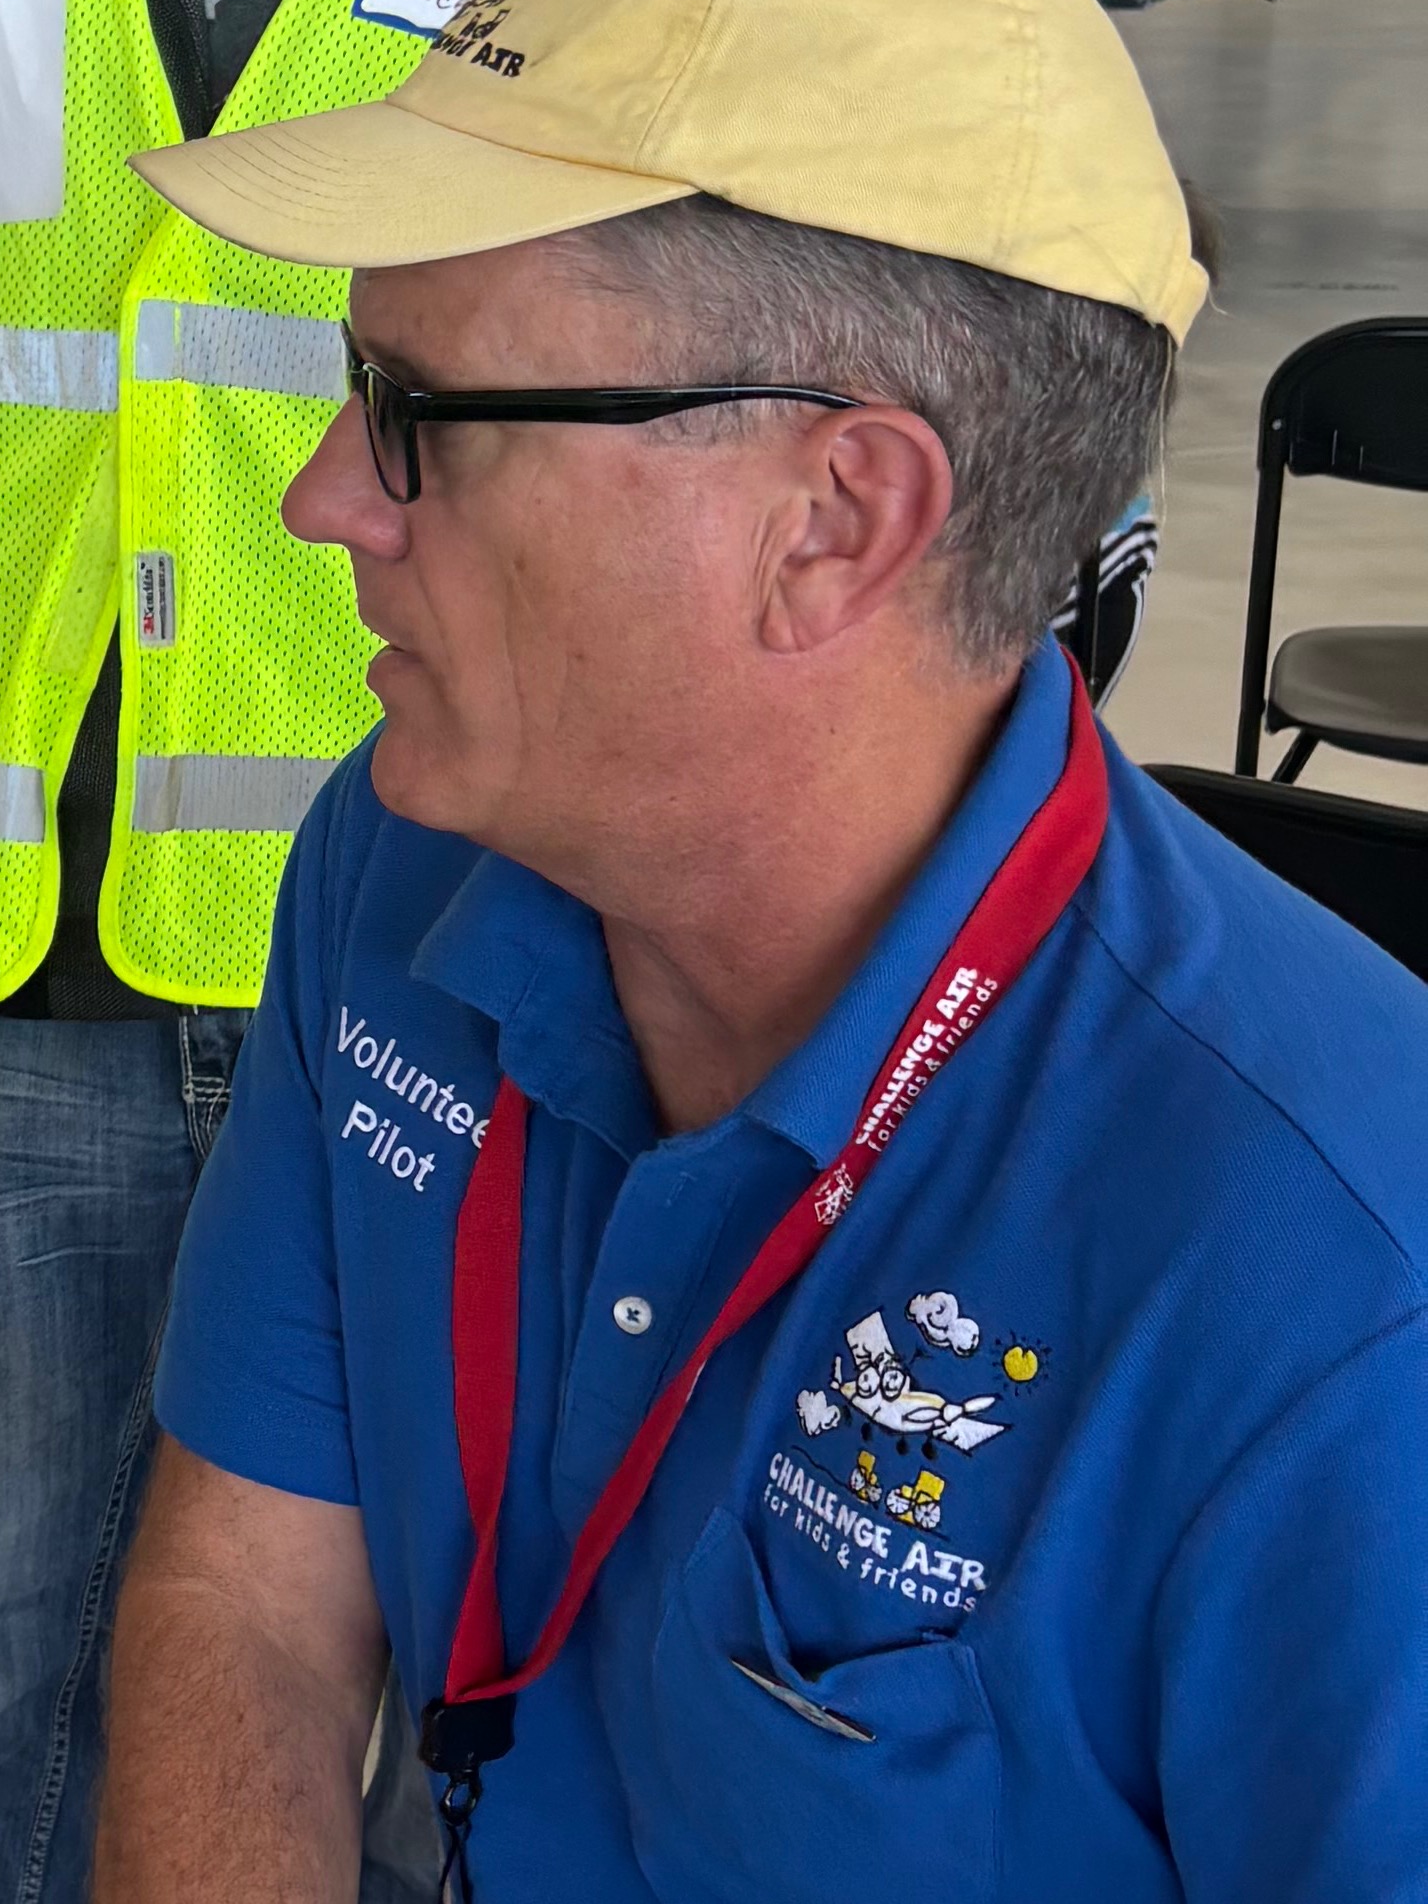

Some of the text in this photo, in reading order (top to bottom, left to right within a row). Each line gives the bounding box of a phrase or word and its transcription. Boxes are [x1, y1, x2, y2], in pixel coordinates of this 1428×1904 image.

[470, 42, 526, 77] AIR
[337, 1006, 491, 1148] Voluntee
[856, 967, 978, 1145] CHALLENGE AIR
[868, 977, 999, 1152] for kids & friends
[341, 1100, 435, 1192] Pilot
[764, 1483, 977, 1612] for kids & friends
[769, 1452, 986, 1591] CHALLENGE AIR
